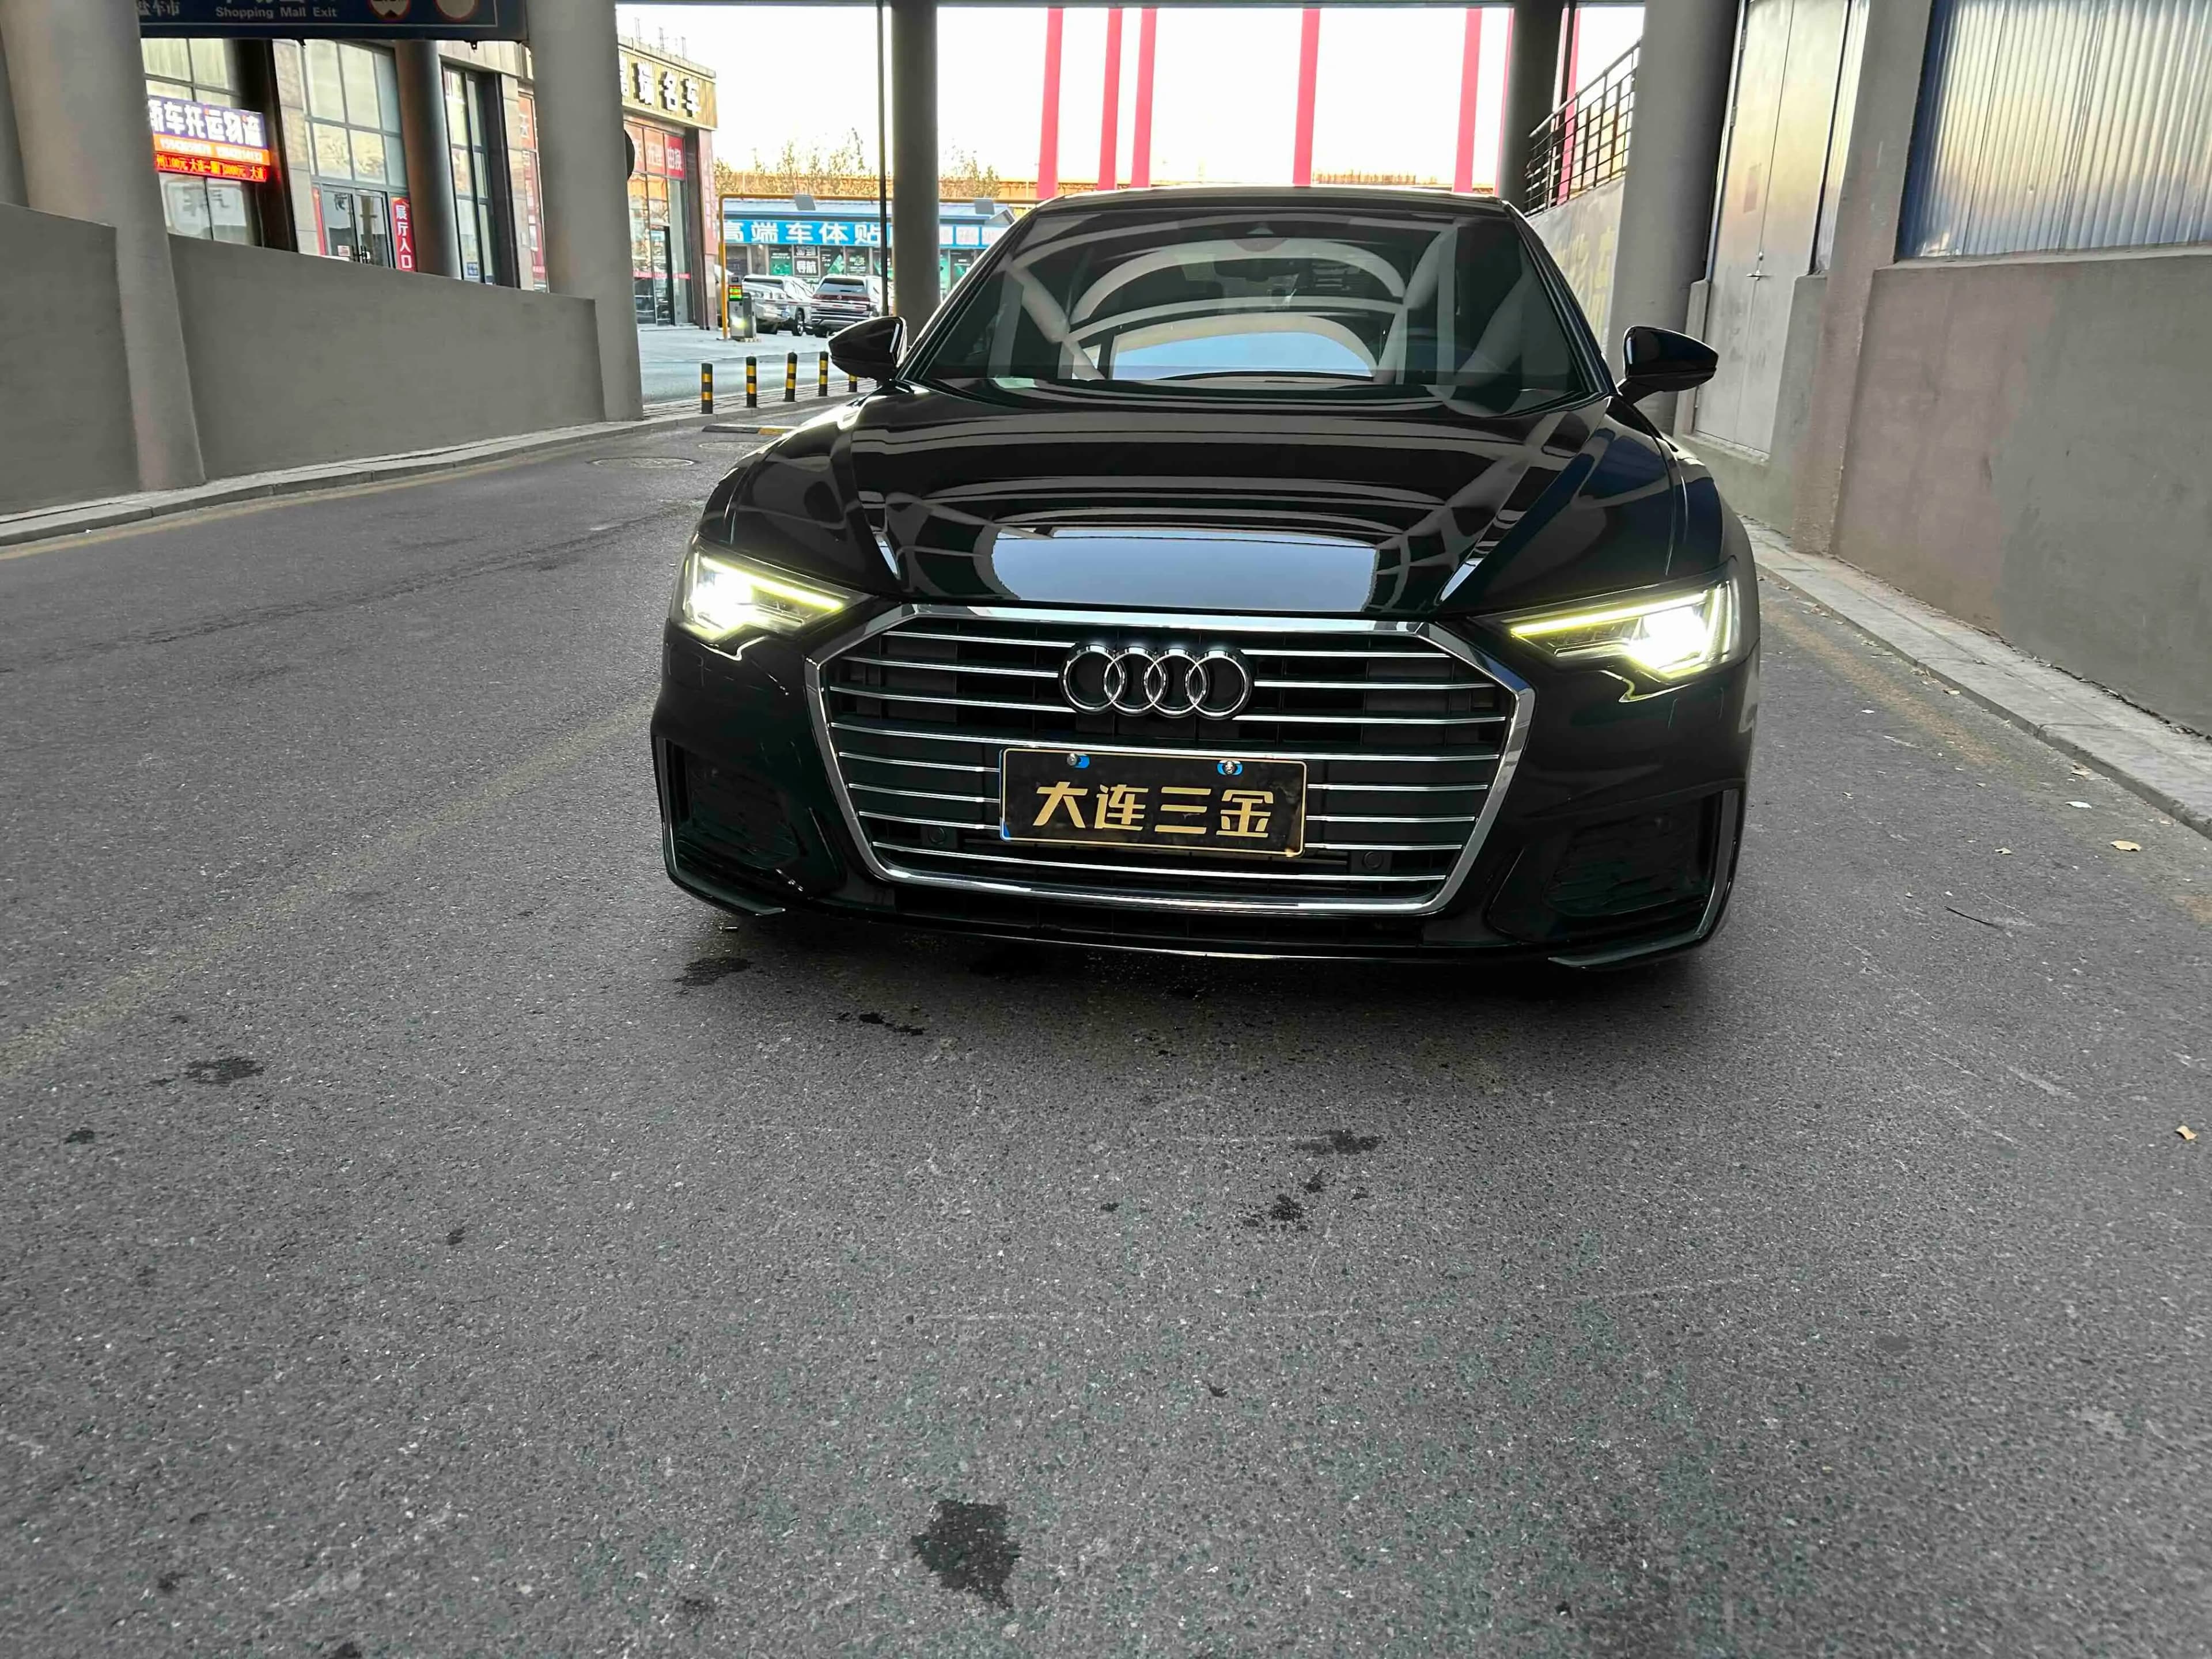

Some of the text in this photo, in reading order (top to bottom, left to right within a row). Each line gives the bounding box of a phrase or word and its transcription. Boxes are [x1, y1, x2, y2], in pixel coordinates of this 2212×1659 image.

[215, 6, 337, 19] Shopping Mall Exit
[395, 204, 412, 269] 展厅入口
[724, 221, 891, 245] 高端车体贴
[1032, 781, 1274, 838] 大连三金
